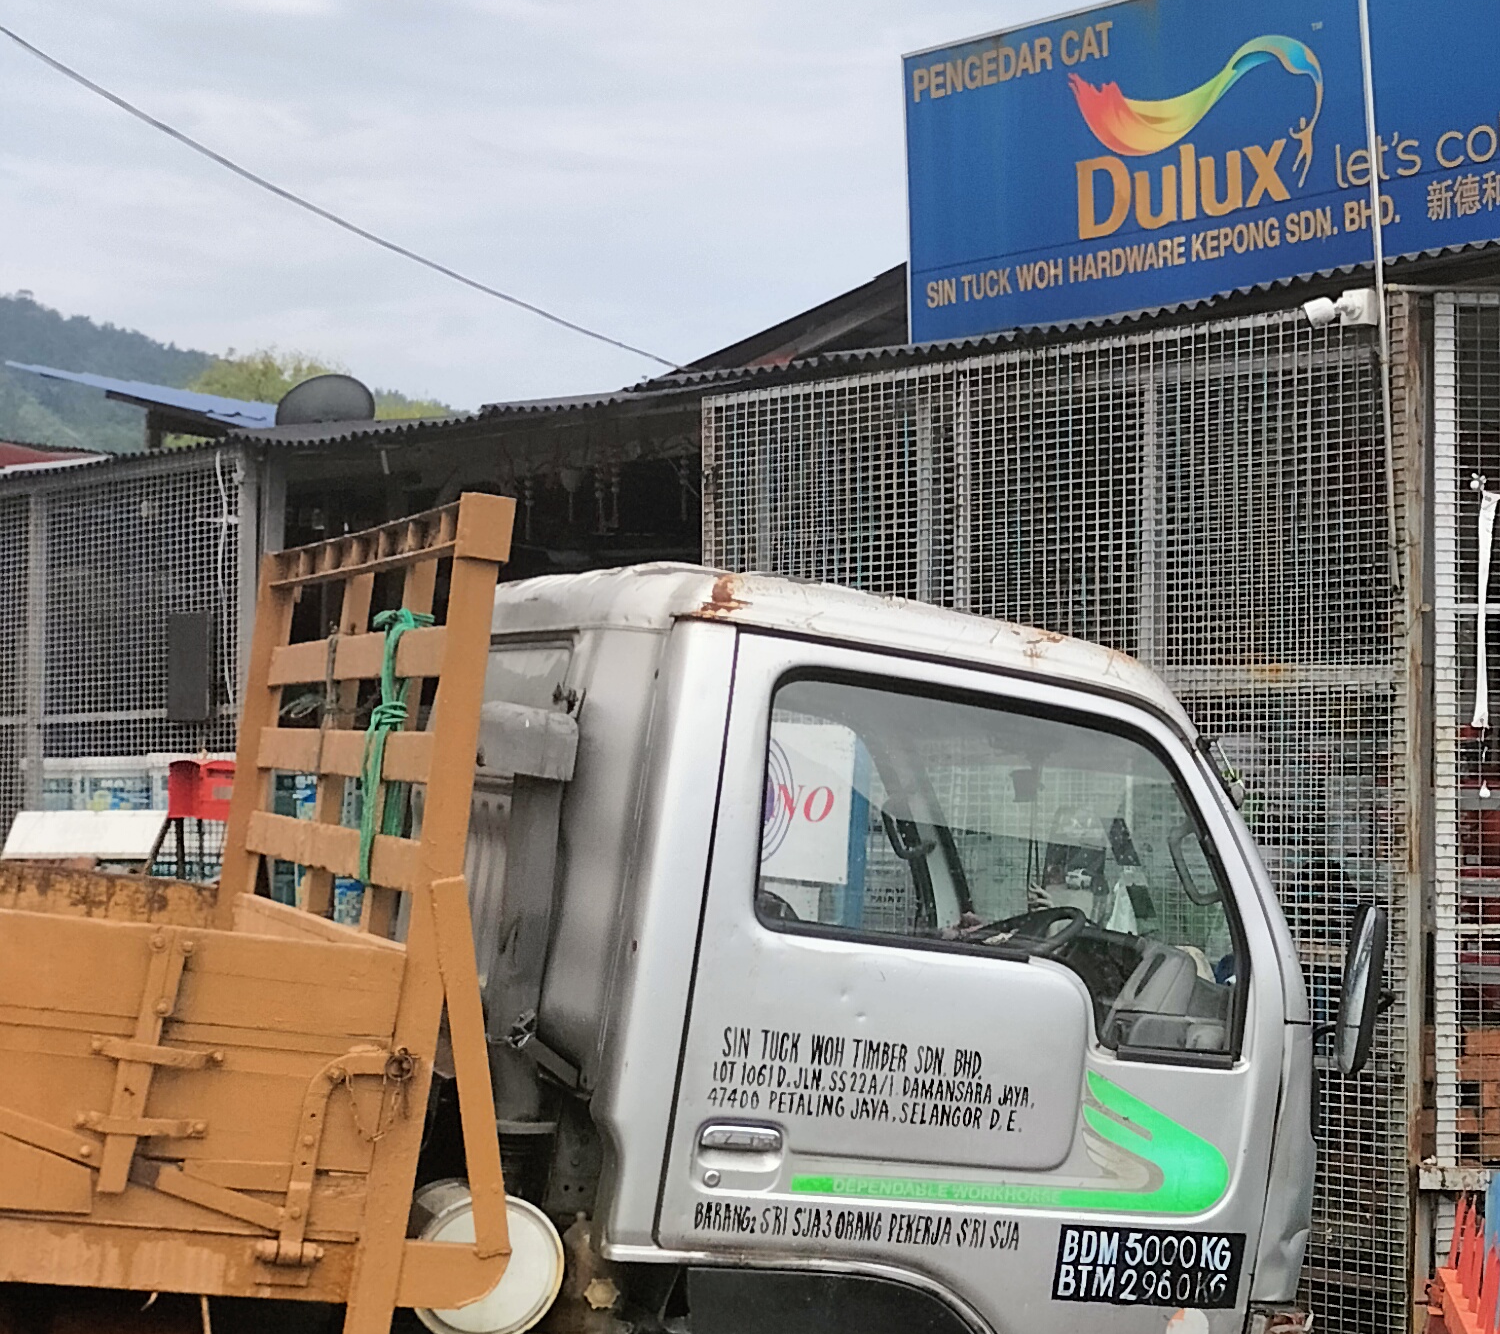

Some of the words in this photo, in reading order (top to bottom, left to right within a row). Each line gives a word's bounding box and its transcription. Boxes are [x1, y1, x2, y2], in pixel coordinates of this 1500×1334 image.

[912, 37, 1053, 103] PENGEDAR
[1060, 21, 1113, 67] CAT
[1335, 131, 1422, 189] let's
[1076, 138, 1291, 240] Dulux
[926, 279, 957, 309] SIN
[961, 268, 1012, 303] TUCK
[1016, 259, 1063, 292] WOH
[1068, 235, 1186, 284] HARDWARE
[1191, 216, 1280, 261] KEPONG
[1285, 206, 1338, 244] SDN.
[1344, 194, 1401, 232] BHD.
[722, 1026, 751, 1060] SIN
[761, 1029, 801, 1064] TUCK
[810, 1033, 846, 1068] WOH
[852, 1038, 908, 1073] TIMBER
[914, 1045, 947, 1078] SDN.
[953, 1048, 983, 1081] BHD.
[712, 1060, 738, 1084] LOT
[902, 1075, 993, 1105] DAMANSARA
[706, 1086, 760, 1110] 47400
[768, 1089, 845, 1118] PETALING
[898, 1101, 983, 1130] SELANGOR
[832, 1177, 949, 1199] DEPENDABLE
[952, 1182, 1060, 1204] WORKHORSE
[834, 1209, 882, 1242] ORANG
[887, 1213, 952, 1247] PEKERJA
[1062, 1229, 1120, 1265] BDM
[1056, 1264, 1116, 1298] BTM
